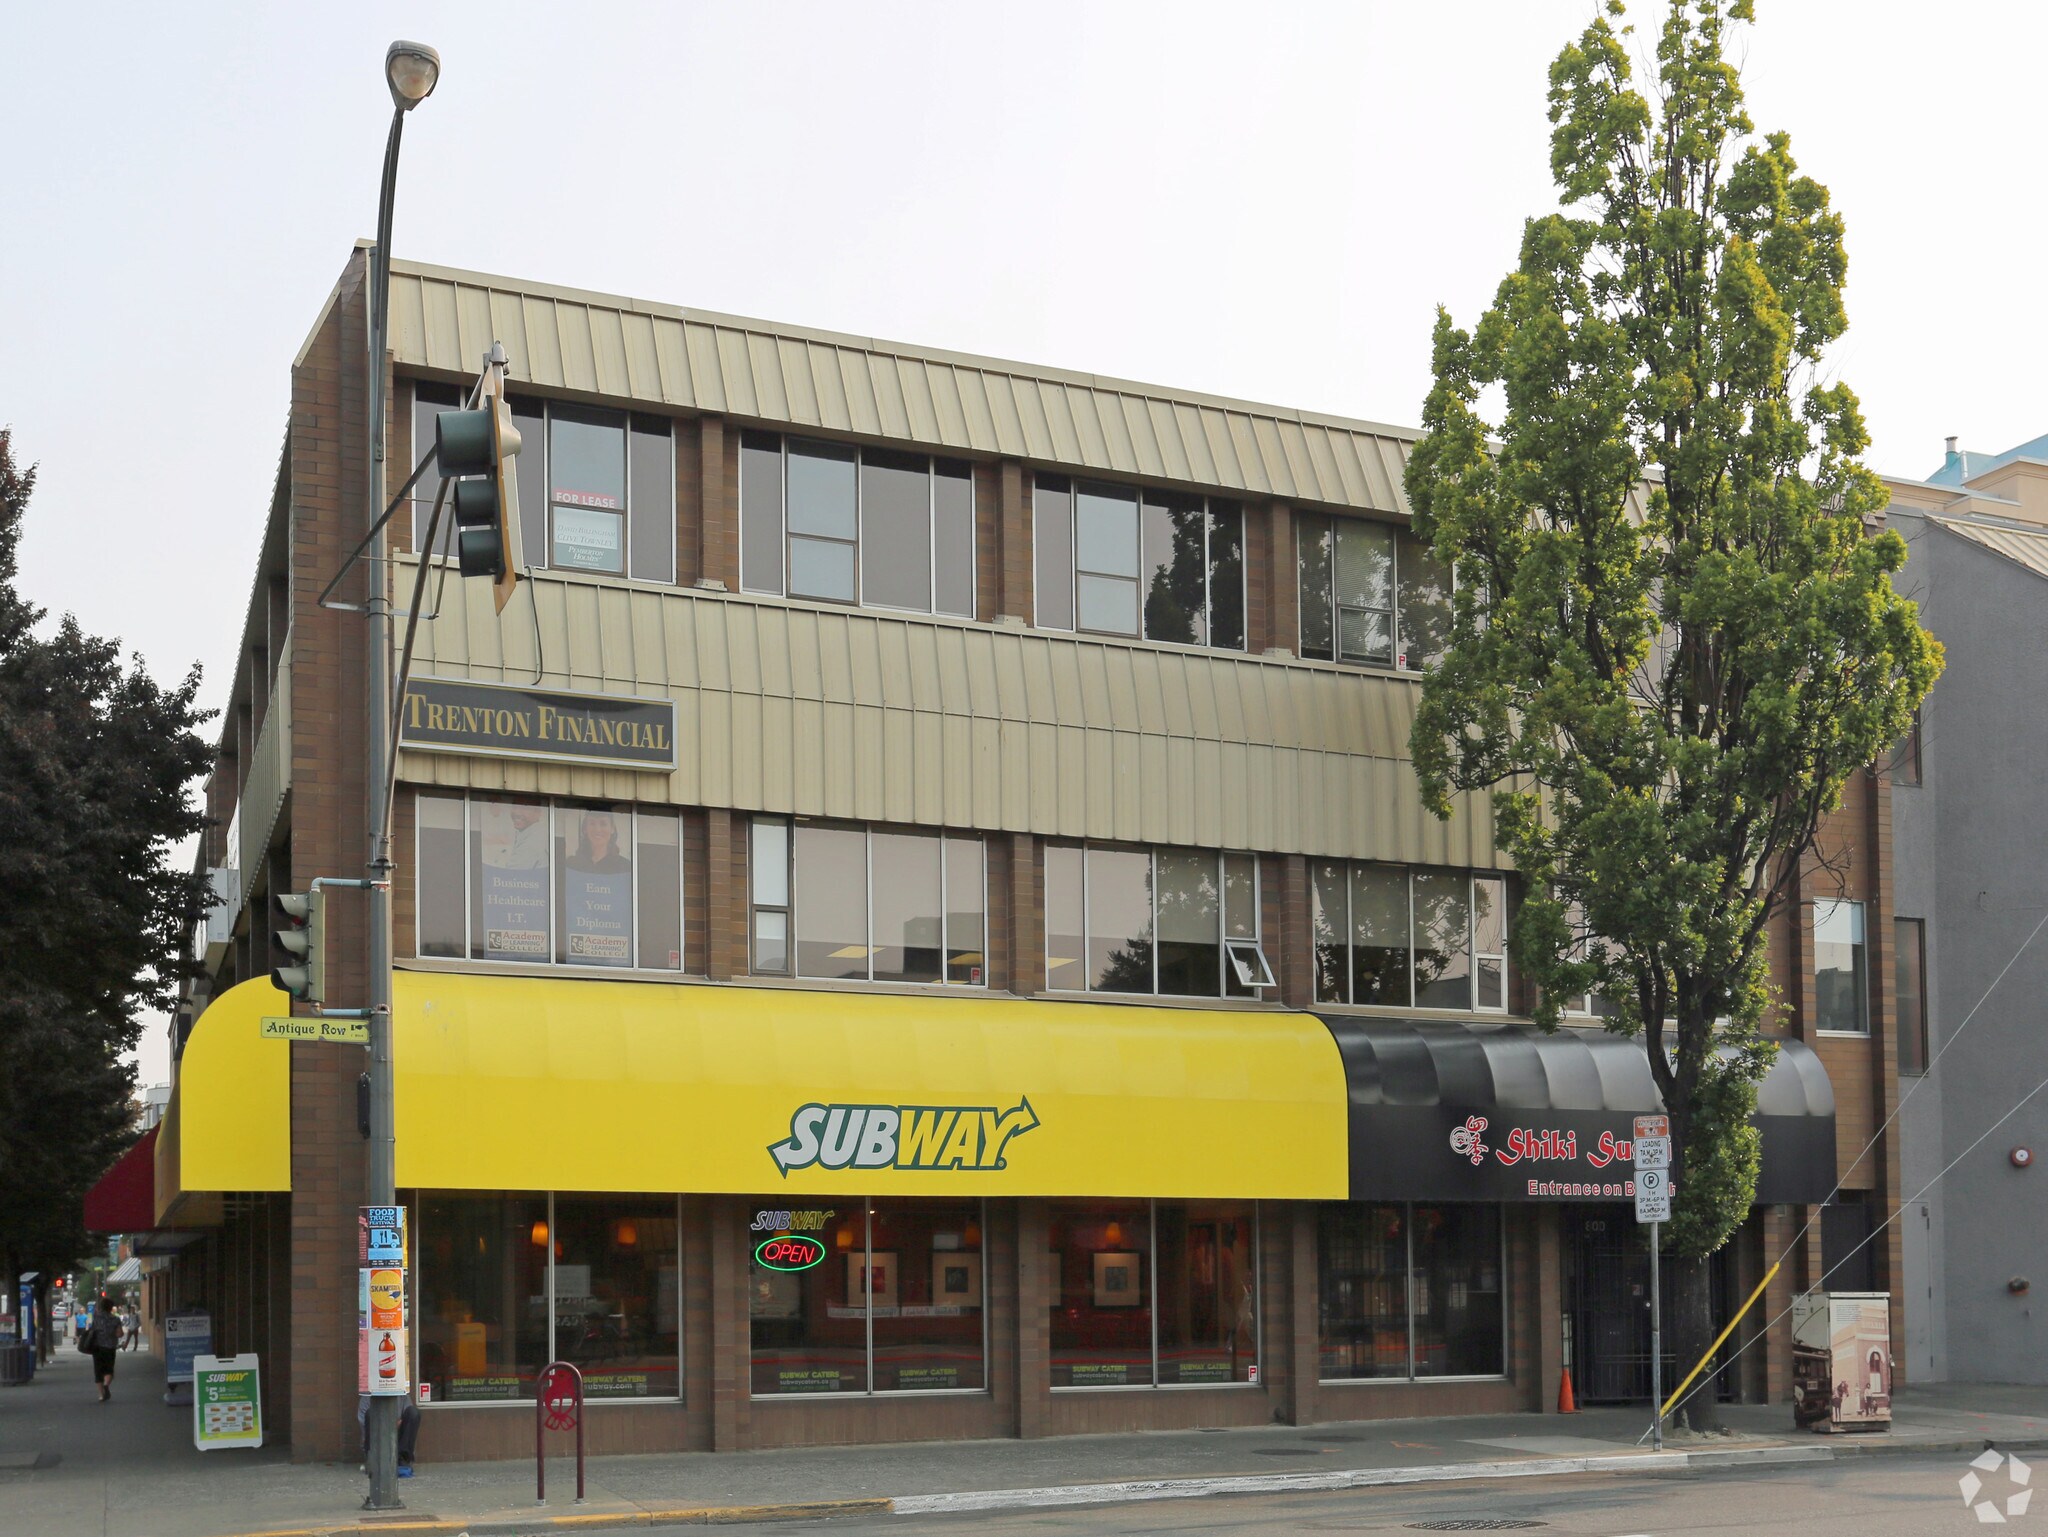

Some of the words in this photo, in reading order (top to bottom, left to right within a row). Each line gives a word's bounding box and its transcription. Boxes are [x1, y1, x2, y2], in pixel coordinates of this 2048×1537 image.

[556, 492, 578, 504] FOR
[582, 496, 616, 508] LEASE
[404, 692, 532, 738] TRENTON
[537, 705, 670, 750] FINANCIAL
[492, 876, 539, 889] Business
[586, 883, 610, 894] Earn
[488, 894, 545, 906] Healthcare
[585, 900, 612, 911] Your
[507, 912, 527, 924] I.T.
[576, 916, 622, 930] Diploma
[502, 931, 546, 943] Academy
[584, 936, 627, 947] Academy
[266, 1022, 315, 1036] Antique
[320, 1024, 346, 1036] Row
[766, 1096, 1040, 1178] SUBWAY
[1496, 1128, 1577, 1166] Shiki
[1642, 1140, 1661, 1148] LOADING
[1528, 1180, 1600, 1196] Entrance
[1605, 1182, 1622, 1196] on
[369, 1208, 395, 1216] FOOD
[750, 1210, 836, 1231] SUBWAY
[764, 1244, 815, 1263] OPEN
[206, 1372, 248, 1382] SUBWAY
[452, 1378, 486, 1386] SUBWAY
